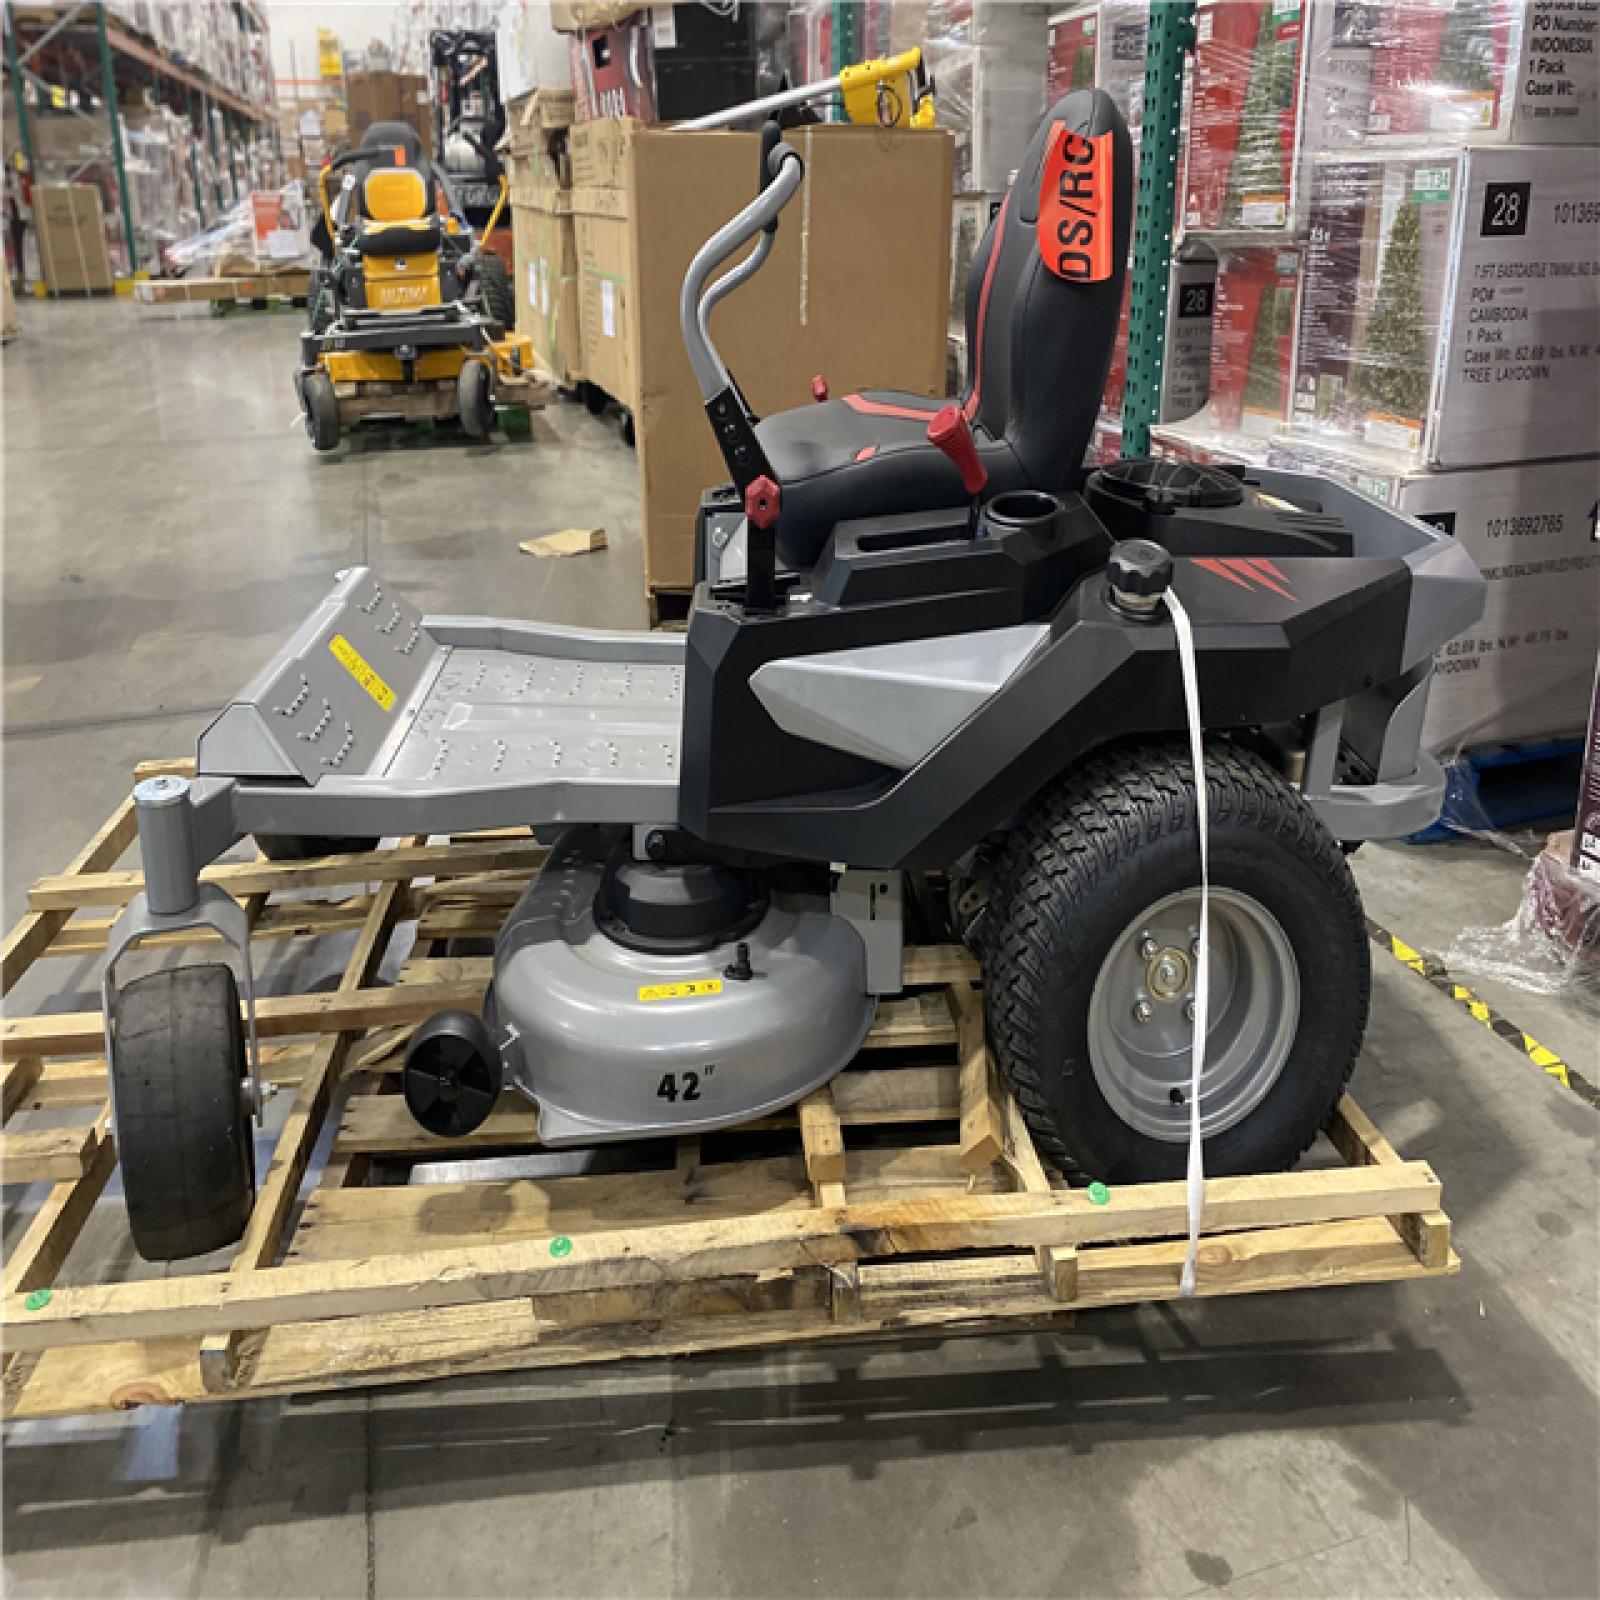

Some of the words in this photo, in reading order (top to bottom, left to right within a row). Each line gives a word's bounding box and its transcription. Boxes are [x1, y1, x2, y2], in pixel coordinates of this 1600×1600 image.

[1533, 14, 1550, 30] PO
[1530, 36, 1593, 53] INDONESIA
[1529, 59, 1536, 74] 1
[1537, 58, 1565, 75] Pack
[1525, 79, 1553, 95] Case
[1058, 134, 1097, 278] DS/RC
[1491, 192, 1519, 226] 28
[1184, 288, 1208, 313] 28
[1469, 306, 1529, 324] CAMBODIA
[1477, 327, 1503, 343] Pack
[1464, 349, 1491, 363] Case
[1462, 366, 1491, 383] TREE
[1494, 364, 1550, 382] LAYDOWN
